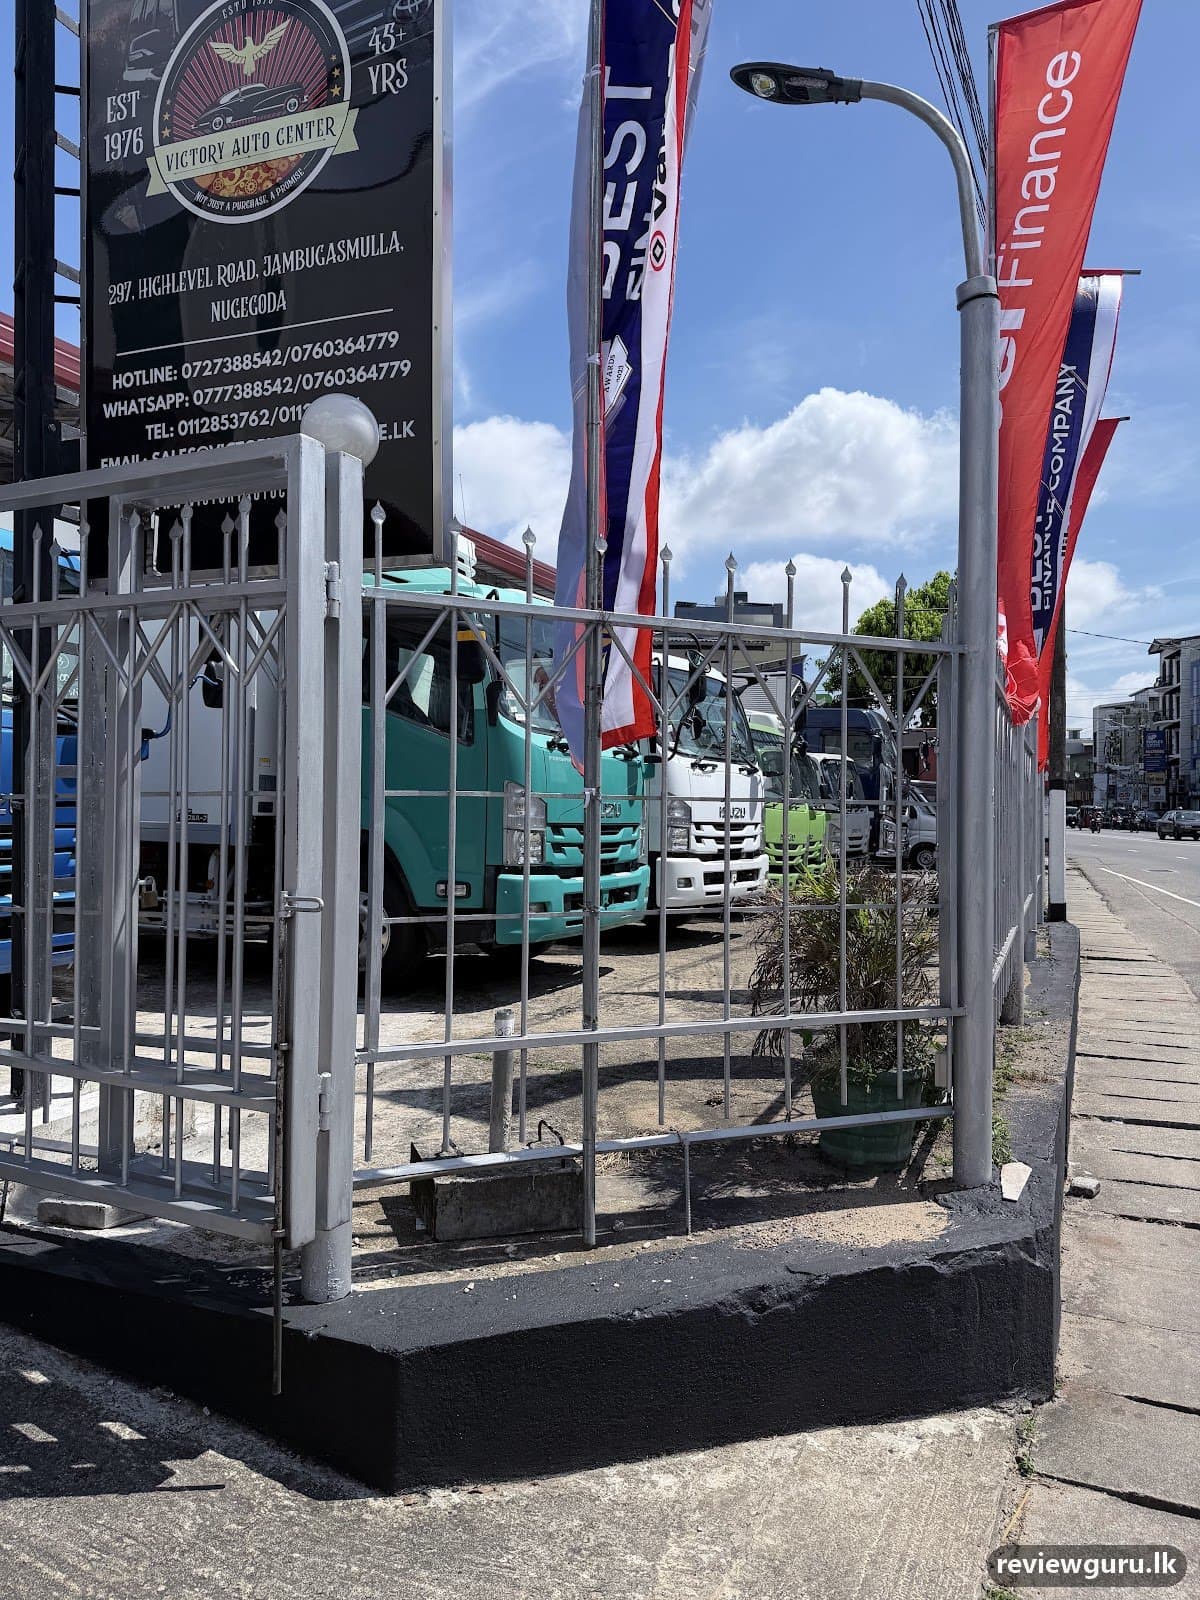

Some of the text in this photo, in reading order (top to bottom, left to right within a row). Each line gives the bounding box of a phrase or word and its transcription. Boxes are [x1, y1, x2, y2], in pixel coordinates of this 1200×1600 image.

[368, 21, 407, 56] 45+
[367, 58, 409, 96] YRS
[106, 90, 142, 124] EST
[103, 126, 145, 162] 1976
[166, 117, 337, 171] VICTORY AUTO CENTER
[997, 50, 1082, 289] Finance
[194, 192, 207, 205] NOT
[207, 200, 225, 211] JUST
[225, 201, 231, 211] A
[270, 191, 277, 201] A
[276, 167, 305, 197] PROMISE
[138, 267, 213, 300] HIGHLEVEL
[210, 289, 287, 323] NUGEGODA
[112, 330, 400, 390] HOTLINE: 0727388542/0760364779
[604, 354, 616, 393] AWARDS
[103, 359, 413, 419] WHATSAPP: 0777388542/0760364779
[145, 423, 174, 442] TEL:
[1049, 362, 1078, 491] COMPANY
